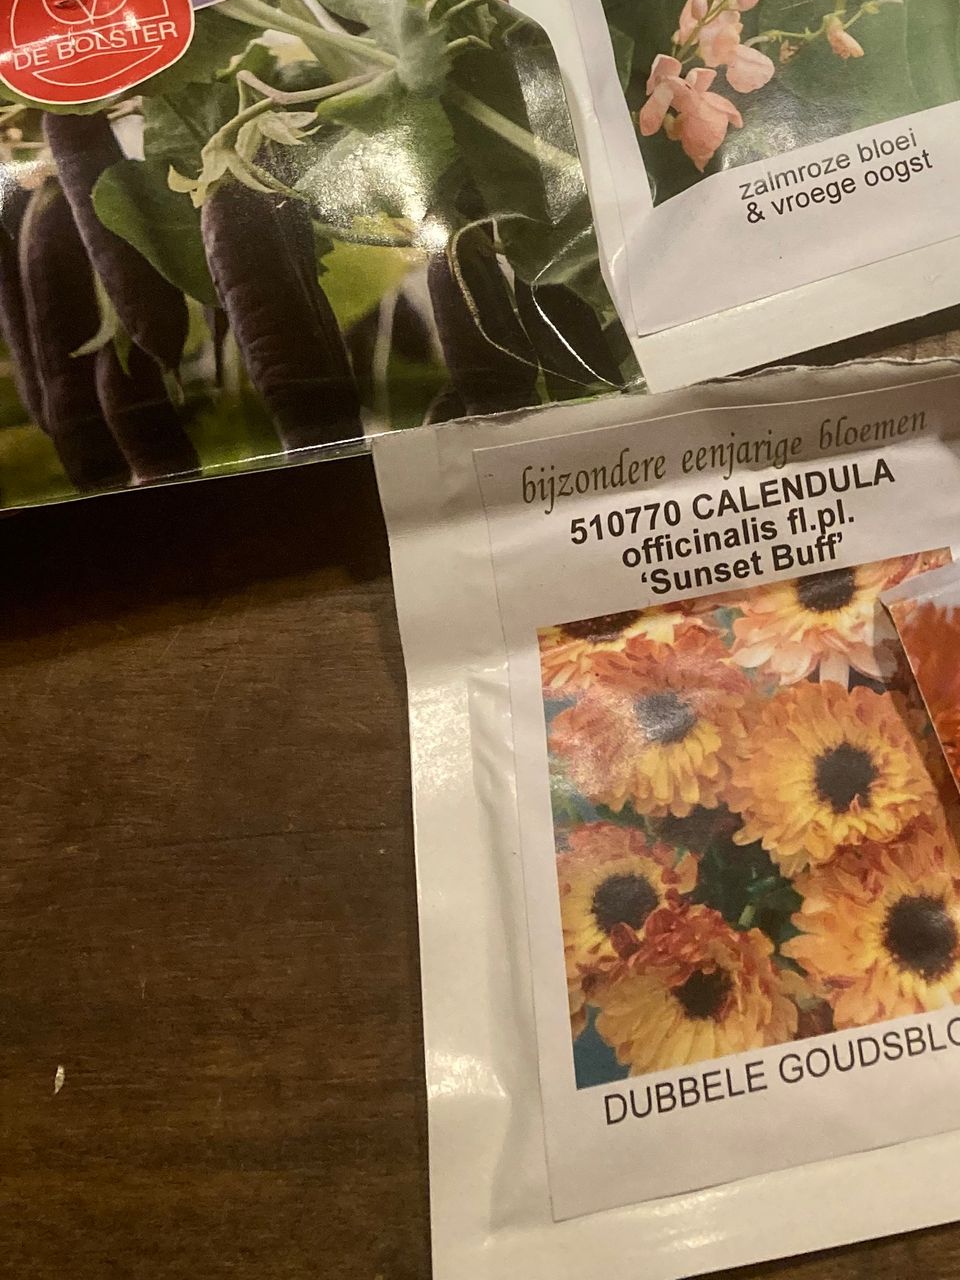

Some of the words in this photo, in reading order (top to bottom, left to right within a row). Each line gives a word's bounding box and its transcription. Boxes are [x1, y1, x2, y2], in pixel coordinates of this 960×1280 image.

[13, 46, 50, 71] DE
[57, 20, 179, 60] BOLSTER
[739, 152, 851, 201] zalmroze
[857, 128, 918, 163] bloei
[746, 201, 766, 224] &
[771, 177, 857, 216] vroege
[864, 149, 933, 188] oogst
[522, 448, 666, 514] bijzondere
[681, 429, 802, 480] eenjarige
[818, 410, 928, 451] bloemen
[570, 500, 682, 545] 510770
[692, 457, 896, 521] CALENDULA
[621, 516, 778, 569] officinalis
[786, 499, 856, 538] fl.pl.
[604, 1060, 768, 1126] DUBBELE
